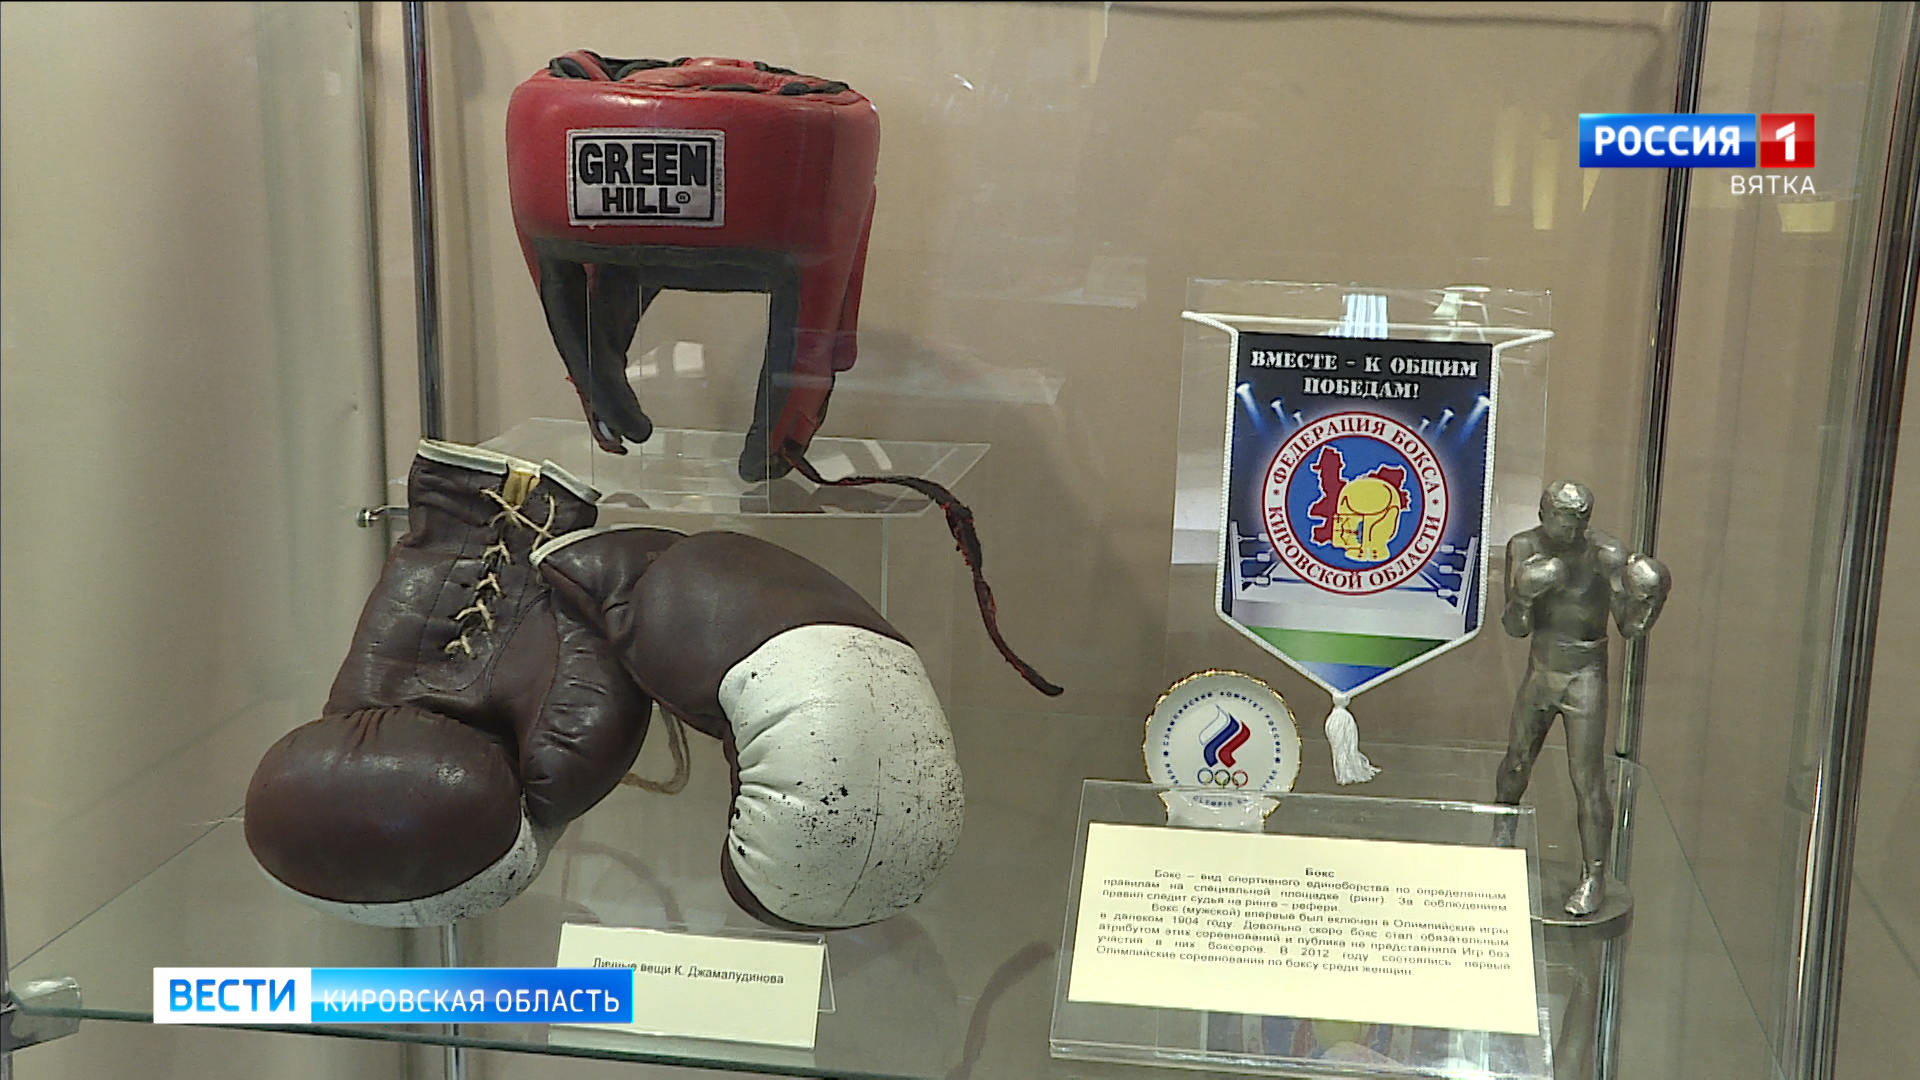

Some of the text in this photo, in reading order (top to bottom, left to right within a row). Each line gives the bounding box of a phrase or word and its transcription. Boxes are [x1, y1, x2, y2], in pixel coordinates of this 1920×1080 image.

[579, 143, 708, 186] GREEN
[1250, 350, 1337, 369] ВМЕСТЕ
[1363, 356, 1382, 373] К
[1390, 357, 1478, 377] ОБЩИМ
[1303, 377, 1420, 400] ПОБЕДАМ!
[1273, 417, 1440, 494] ФЕДЕРАЦИЯ БОКСА
[1268, 505, 1442, 590] КИРОВСКОЙ ОБЛАСТИ
[1154, 869, 1182, 880] Бокс
[1200, 874, 1222, 884] вид
[1228, 876, 1300, 887] спортивного
[1306, 881, 1389, 894] единоборства
[1416, 888, 1506, 901] определенным
[1305, 866, 1334, 877] Бокс
[1102, 889, 1143, 899] правил
[1146, 892, 1187, 902] следит
[1190, 895, 1224, 905] судья
[1244, 899, 1278, 908] ринге
[1292, 900, 1340, 913] рефери.
[1104, 879, 1159, 889] правилам
[1193, 884, 1270, 896] специальной
[1280, 890, 1338, 901] площадке
[1349, 892, 1386, 906] (ринг).
[1398, 895, 1413, 905] За
[1424, 898, 1506, 912] соблюдением
[1100, 912, 1106, 920] в
[1113, 913, 1163, 923] далеком
[1172, 915, 1198, 926] 1904
[1242, 920, 1302, 933] Довольно
[1308, 926, 1342, 937] скоро
[1350, 927, 1378, 938] бокс
[1384, 932, 1412, 940] стал
[1420, 932, 1508, 947] обязательным
[1151, 903, 1178, 914] Бокс
[1182, 905, 1240, 920] (мужской)
[1244, 911, 1295, 922] впервые
[1298, 912, 1323, 923] был
[1327, 916, 1378, 926] включен
[1393, 918, 1475, 932] Олимпийские
[1480, 926, 1508, 937] игры
[1096, 944, 1176, 959] Олимпийские
[1179, 952, 1264, 965] соревнования
[1268, 958, 1282, 966] по
[1285, 957, 1318, 971] боксу
[1322, 962, 1358, 972] среди
[1097, 935, 1142, 945] участия
[1174, 940, 1196, 949] них
[1208, 940, 1266, 955] боксеров.
[1280, 945, 1288, 955] В
[1300, 947, 1329, 958] 2012
[1342, 952, 1368, 963] году
[1382, 955, 1452, 966] состоялись
[1464, 961, 1510, 971] первые
[1098, 923, 1160, 935] атрибутом
[1164, 928, 1190, 937] этих
[1196, 930, 1280, 943] соревнований
[1297, 936, 1346, 948] публика
[1351, 941, 1366, 949] не
[1370, 943, 1456, 956] представляла
[1462, 947, 1483, 960] Игр
[1488, 949, 1510, 959] без
[640, 962, 671, 976] вещи
[674, 965, 684, 976] К.
[688, 965, 784, 984] Джамалудинова
